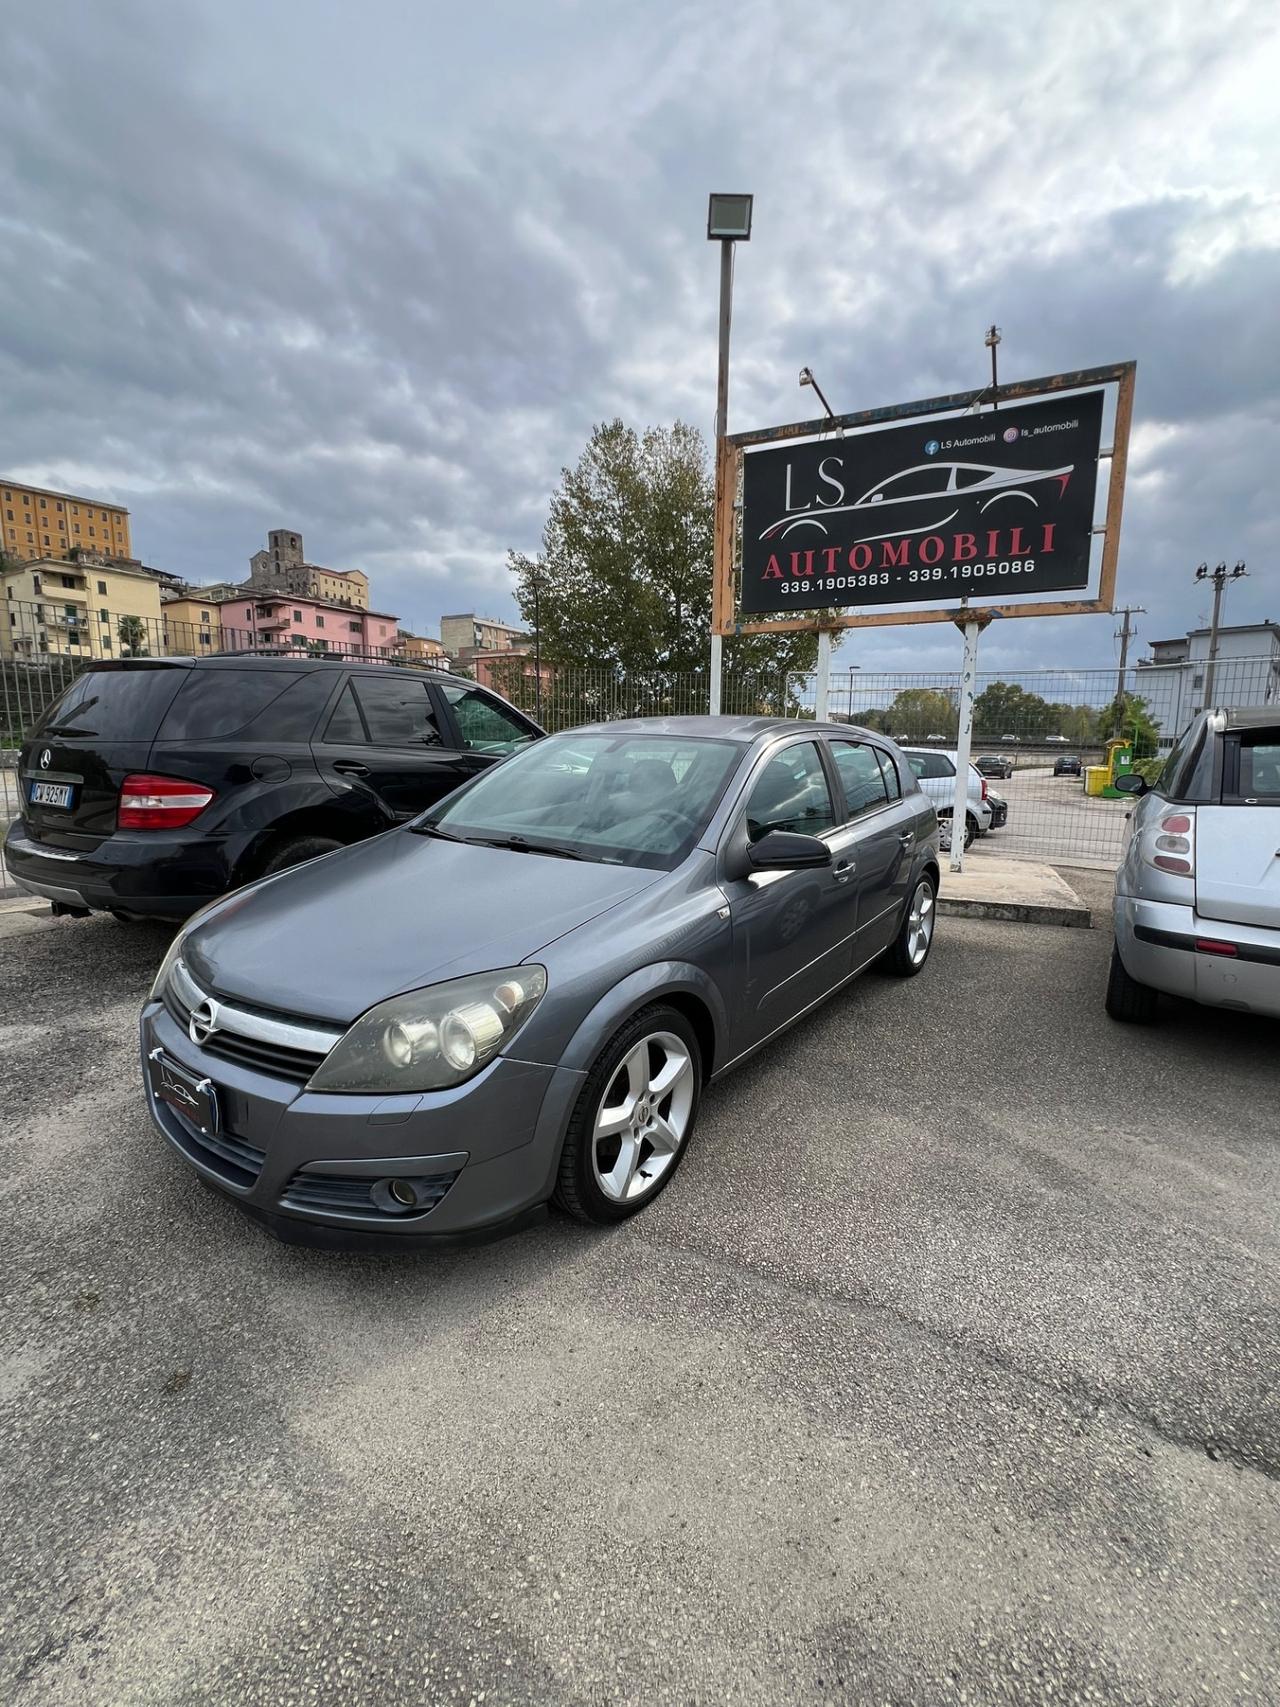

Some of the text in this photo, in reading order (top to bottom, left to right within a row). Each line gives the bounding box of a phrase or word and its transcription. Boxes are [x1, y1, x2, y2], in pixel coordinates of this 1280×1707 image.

[940, 431, 996, 450] LS Automobili
[1021, 419, 1079, 438] ls_automobili
[785, 457, 845, 511] LS
[761, 523, 1057, 580] AUTOMOBILI
[780, 573, 890, 594] 339.1905383
[908, 559, 1036, 583] 339.1905086
